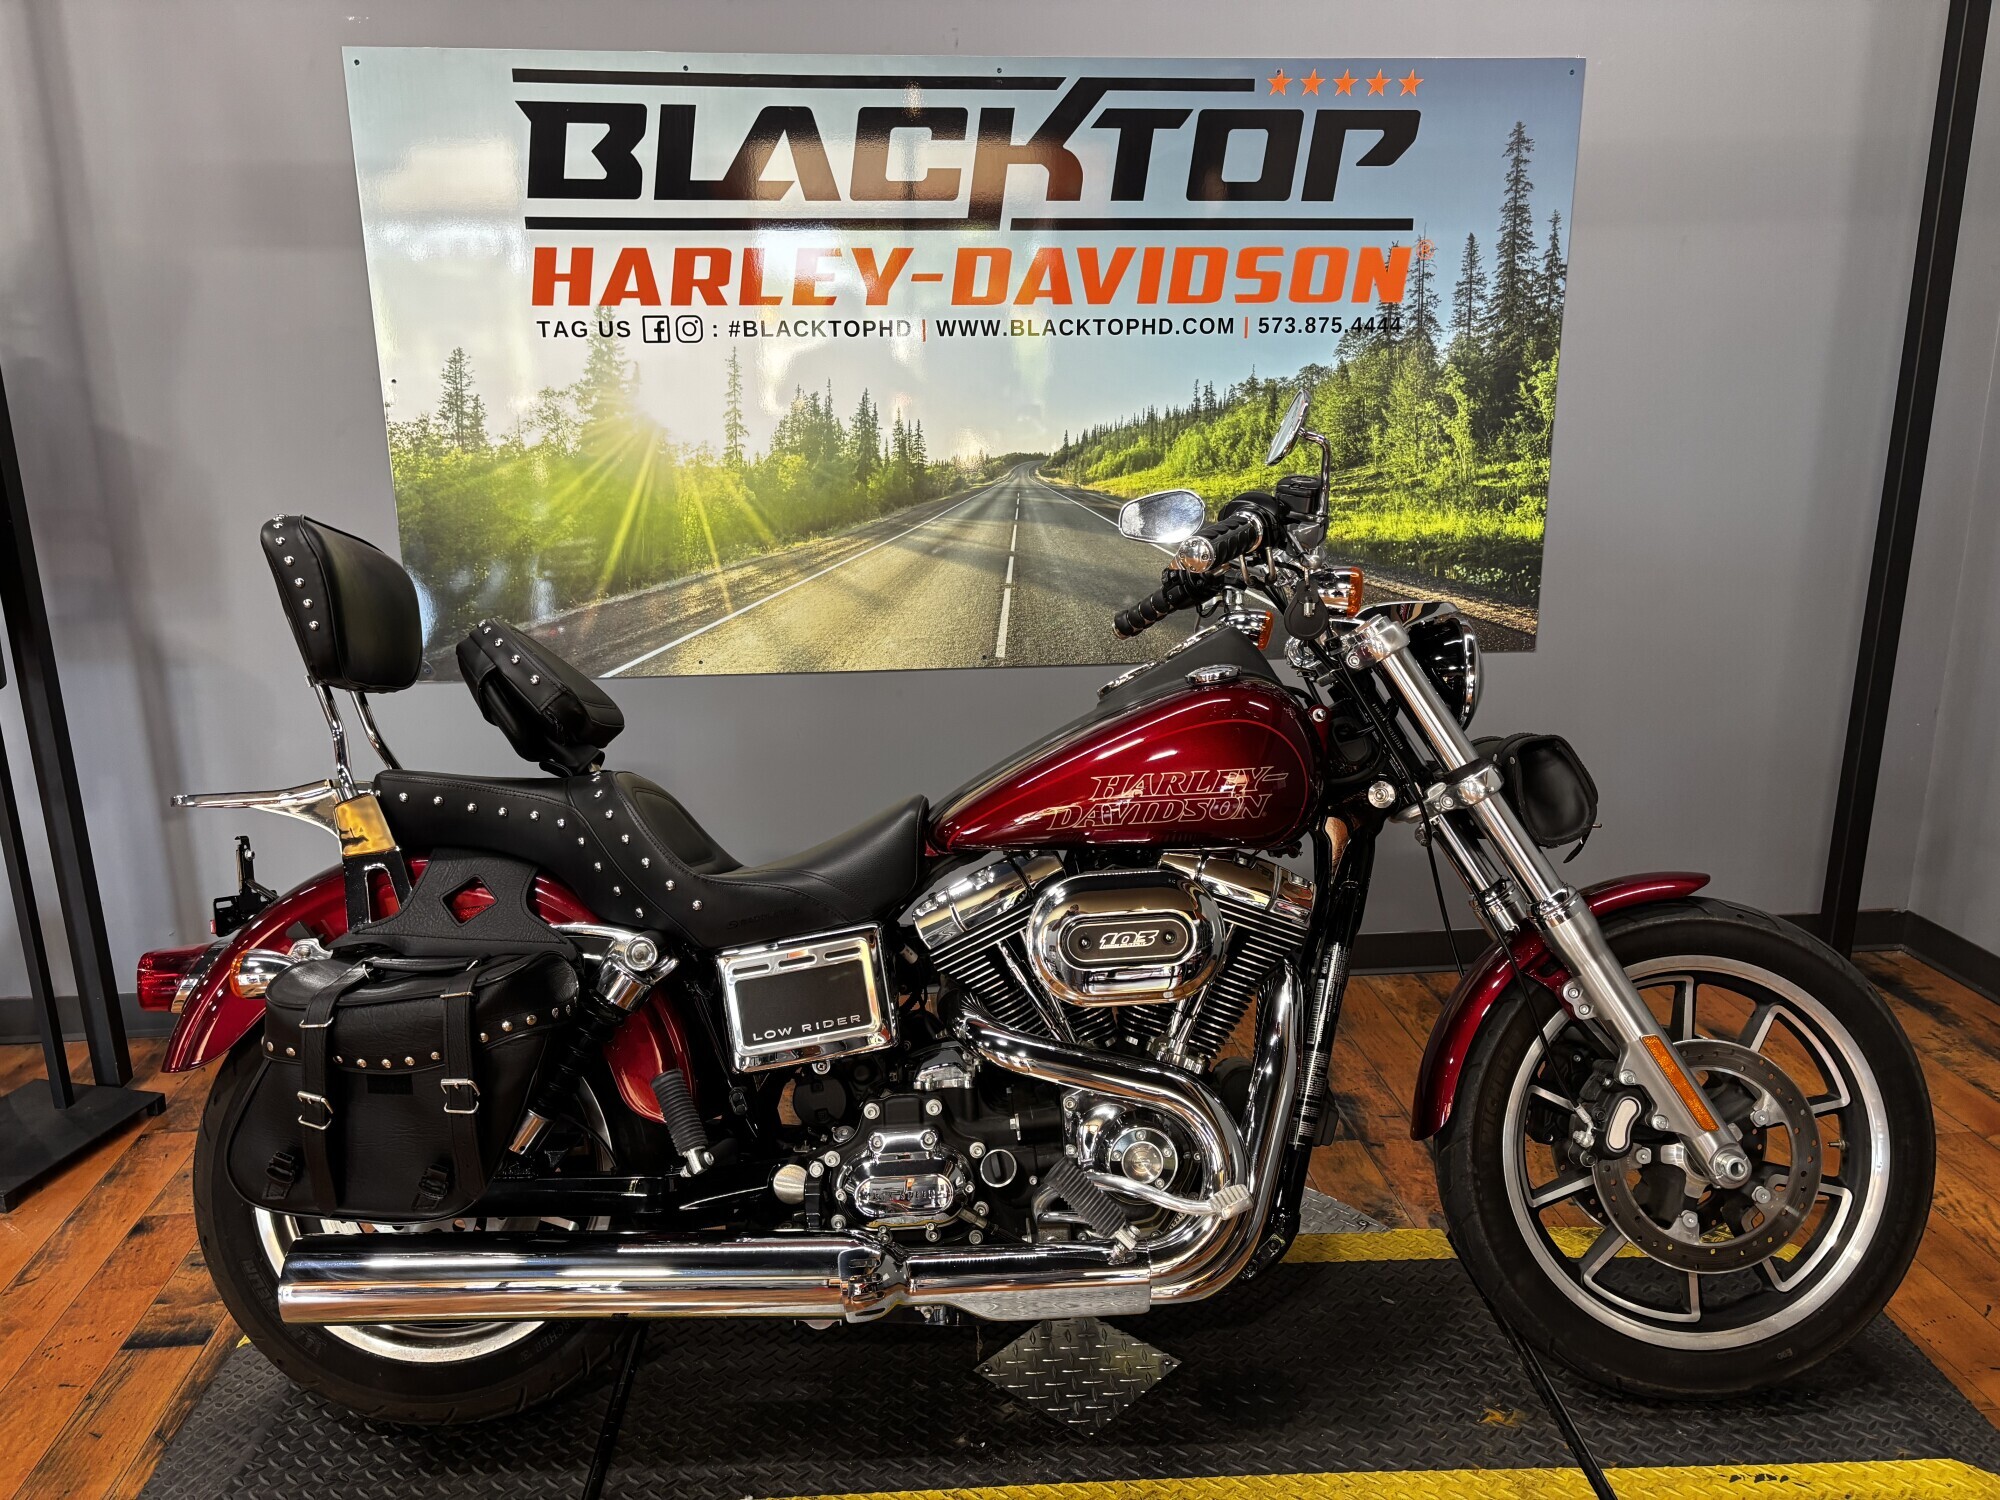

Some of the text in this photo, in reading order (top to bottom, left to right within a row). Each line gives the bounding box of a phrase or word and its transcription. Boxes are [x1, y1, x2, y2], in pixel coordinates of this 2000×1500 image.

[515, 77, 1421, 230] BLACKTOP
[531, 246, 1411, 307] HARLEY-DAVIDSON
[536, 320, 588, 338] TAG
[598, 320, 631, 338] US
[728, 320, 911, 338] #BLACKTOPHD
[936, 317, 1234, 337] WWW.BLACKTOPHD.COM
[1257, 316, 1402, 334] 573.875.4444
[1046, 794, 1272, 831] DAVIDSON
[1099, 929, 1160, 950] 103
[752, 1014, 862, 1042] LOW RIDER
